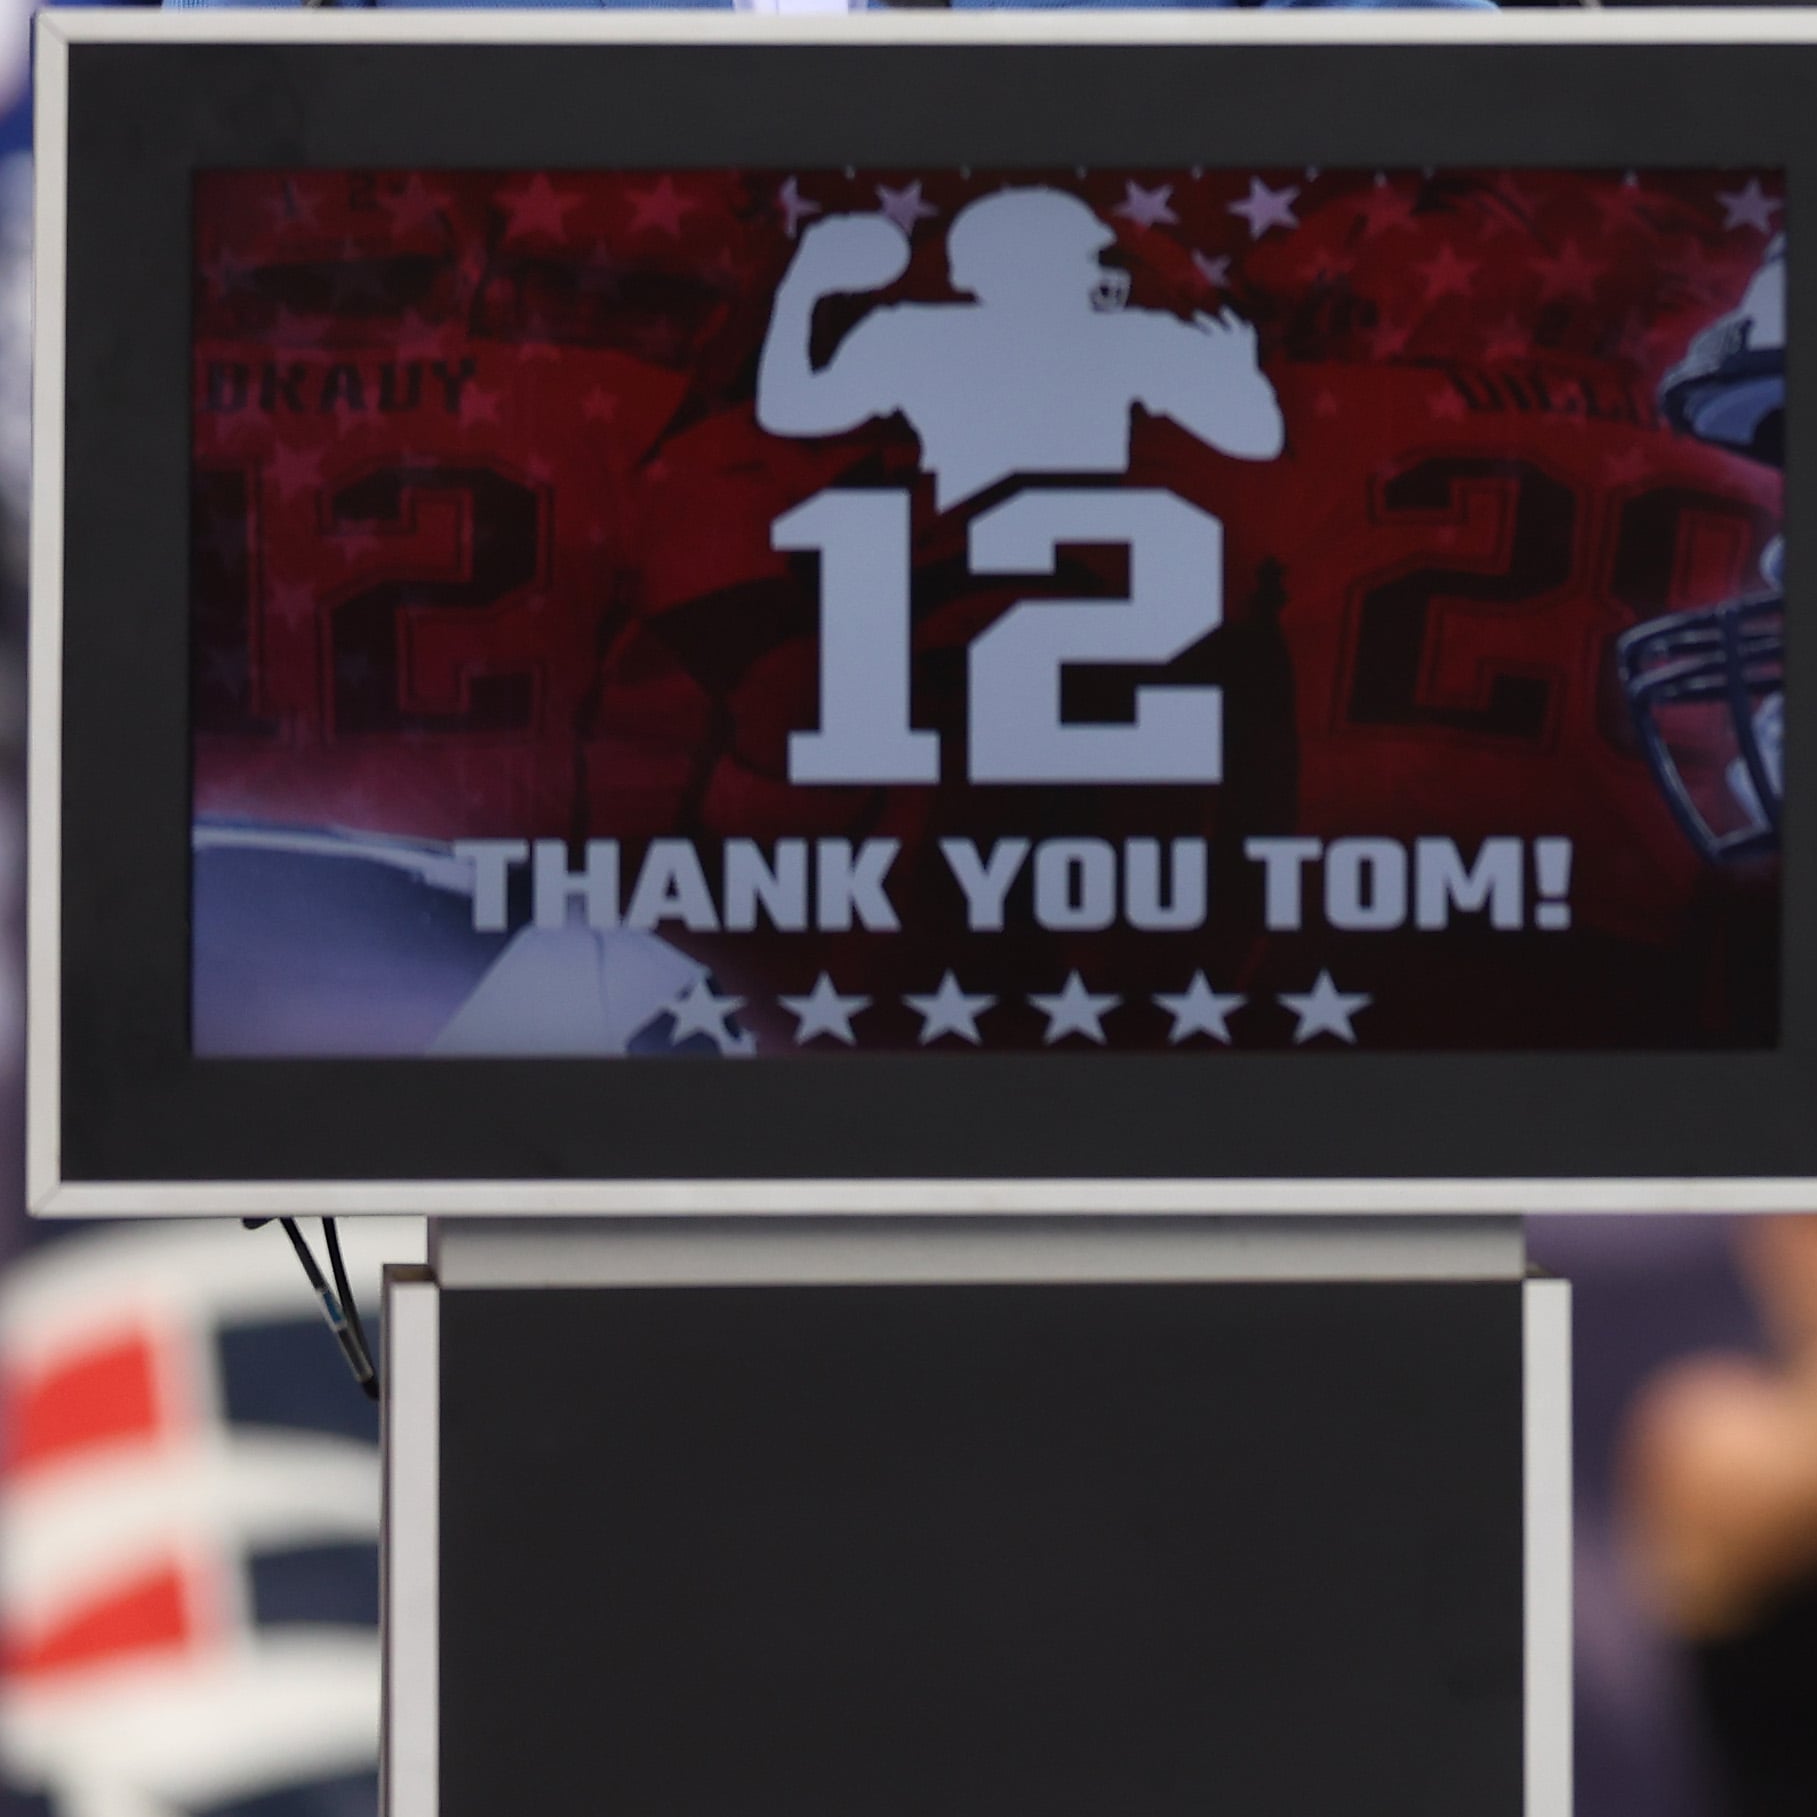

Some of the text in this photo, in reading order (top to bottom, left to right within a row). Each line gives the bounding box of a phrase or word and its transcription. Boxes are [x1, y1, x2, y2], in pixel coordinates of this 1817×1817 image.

[770, 487, 1224, 785] 12
[453, 838, 1572, 932] THANK YOU TOM!
